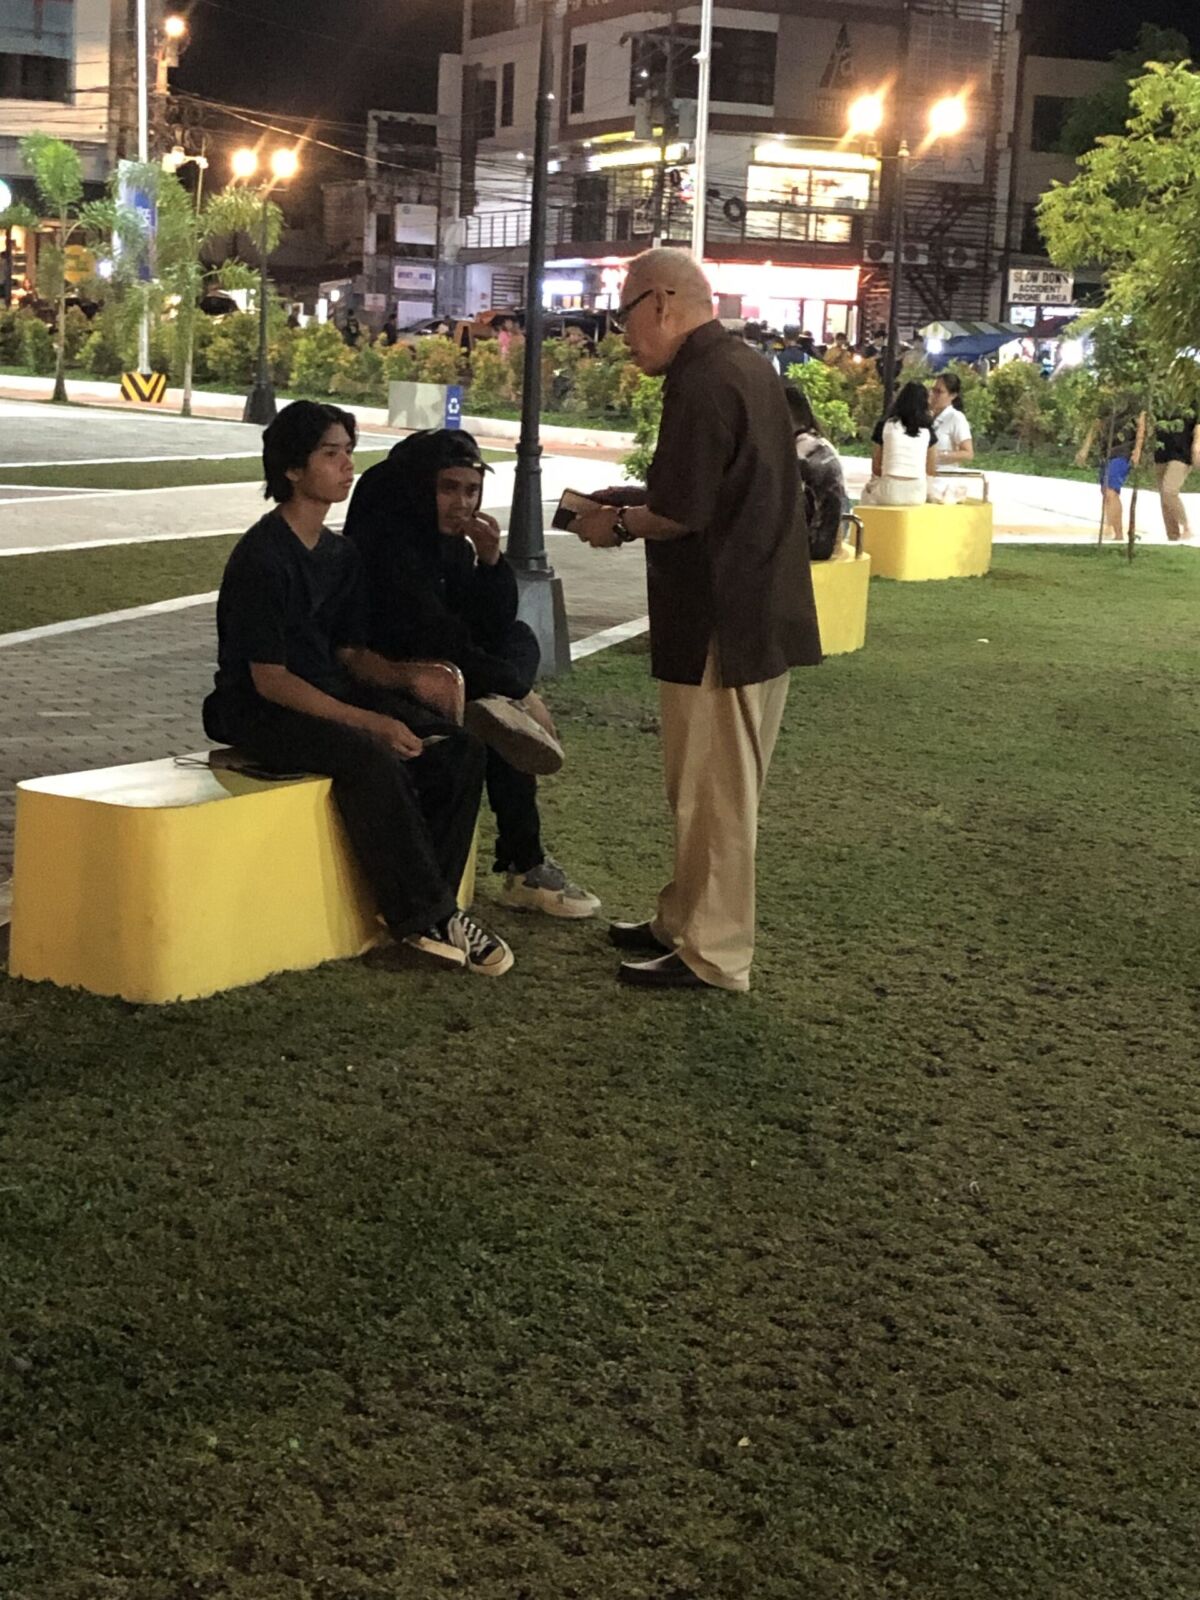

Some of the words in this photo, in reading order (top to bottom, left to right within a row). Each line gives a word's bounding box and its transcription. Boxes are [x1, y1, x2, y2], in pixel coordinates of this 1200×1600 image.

[1014, 271, 1039, 283] SLOW
[1019, 284, 1061, 293] ACCIDENT
[1012, 293, 1041, 301] PRONE
[1045, 294, 1067, 302] AREA
